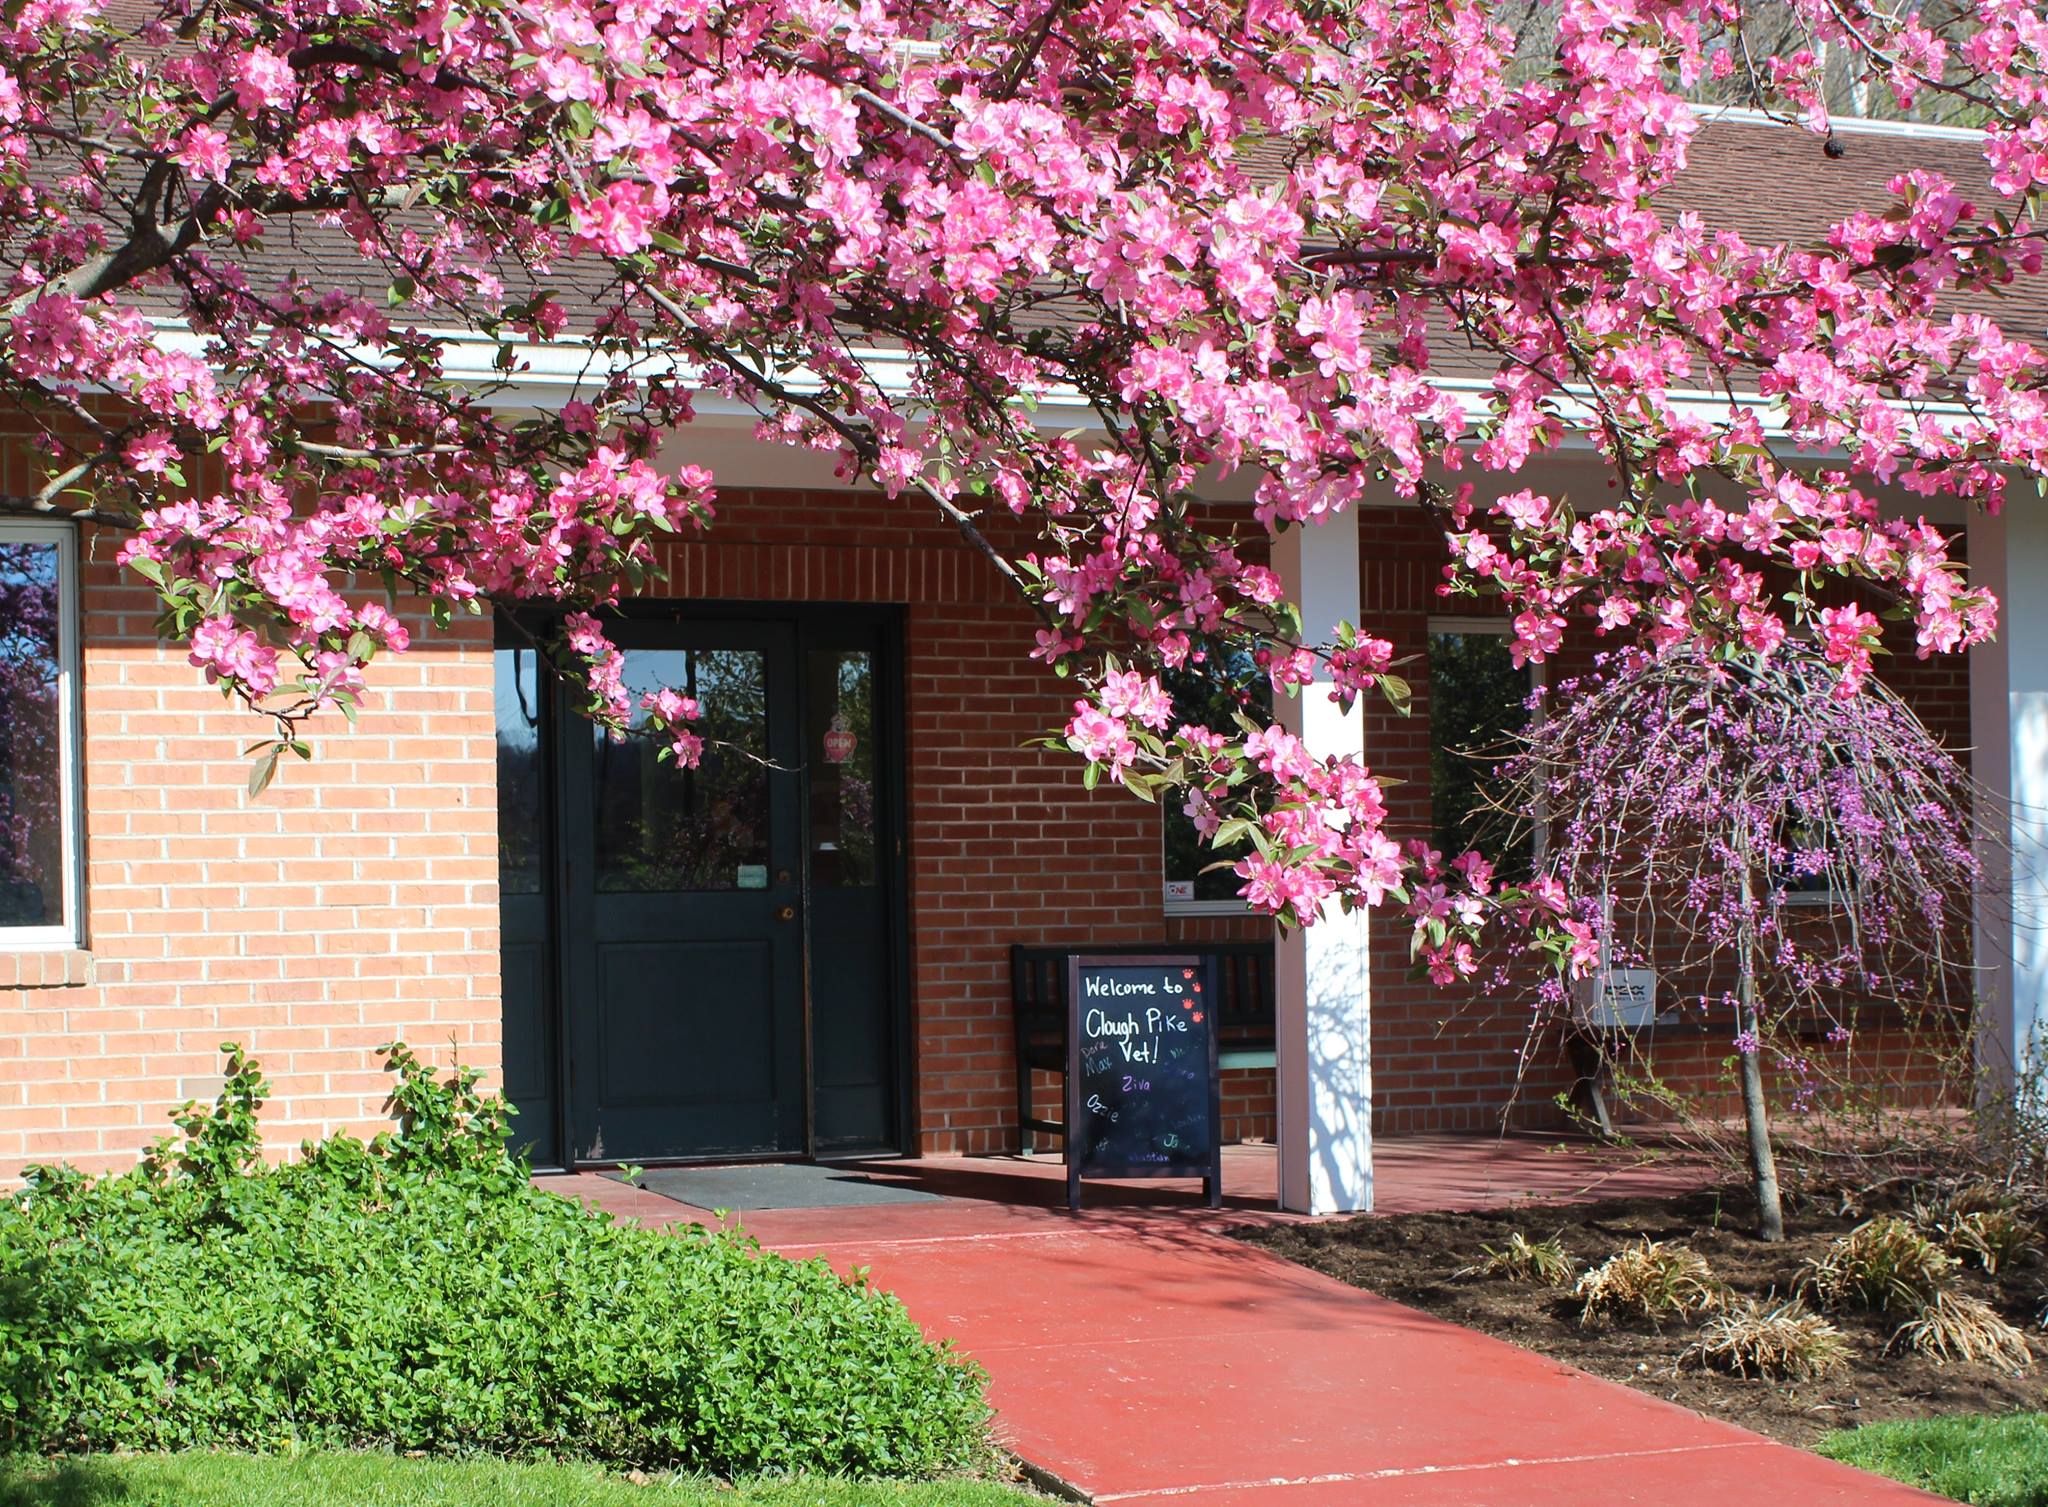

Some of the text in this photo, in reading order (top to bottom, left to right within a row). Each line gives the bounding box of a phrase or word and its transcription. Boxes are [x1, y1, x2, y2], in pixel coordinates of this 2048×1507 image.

[1086, 976, 1183, 997] Welcome to
[1086, 1008, 1139, 1043] Clough
[1119, 1036, 1158, 1064] Vet!
[1085, 1056, 1112, 1077] Max
[1122, 1075, 1150, 1092] Ziva
[1087, 1094, 1119, 1122] Ozzie
